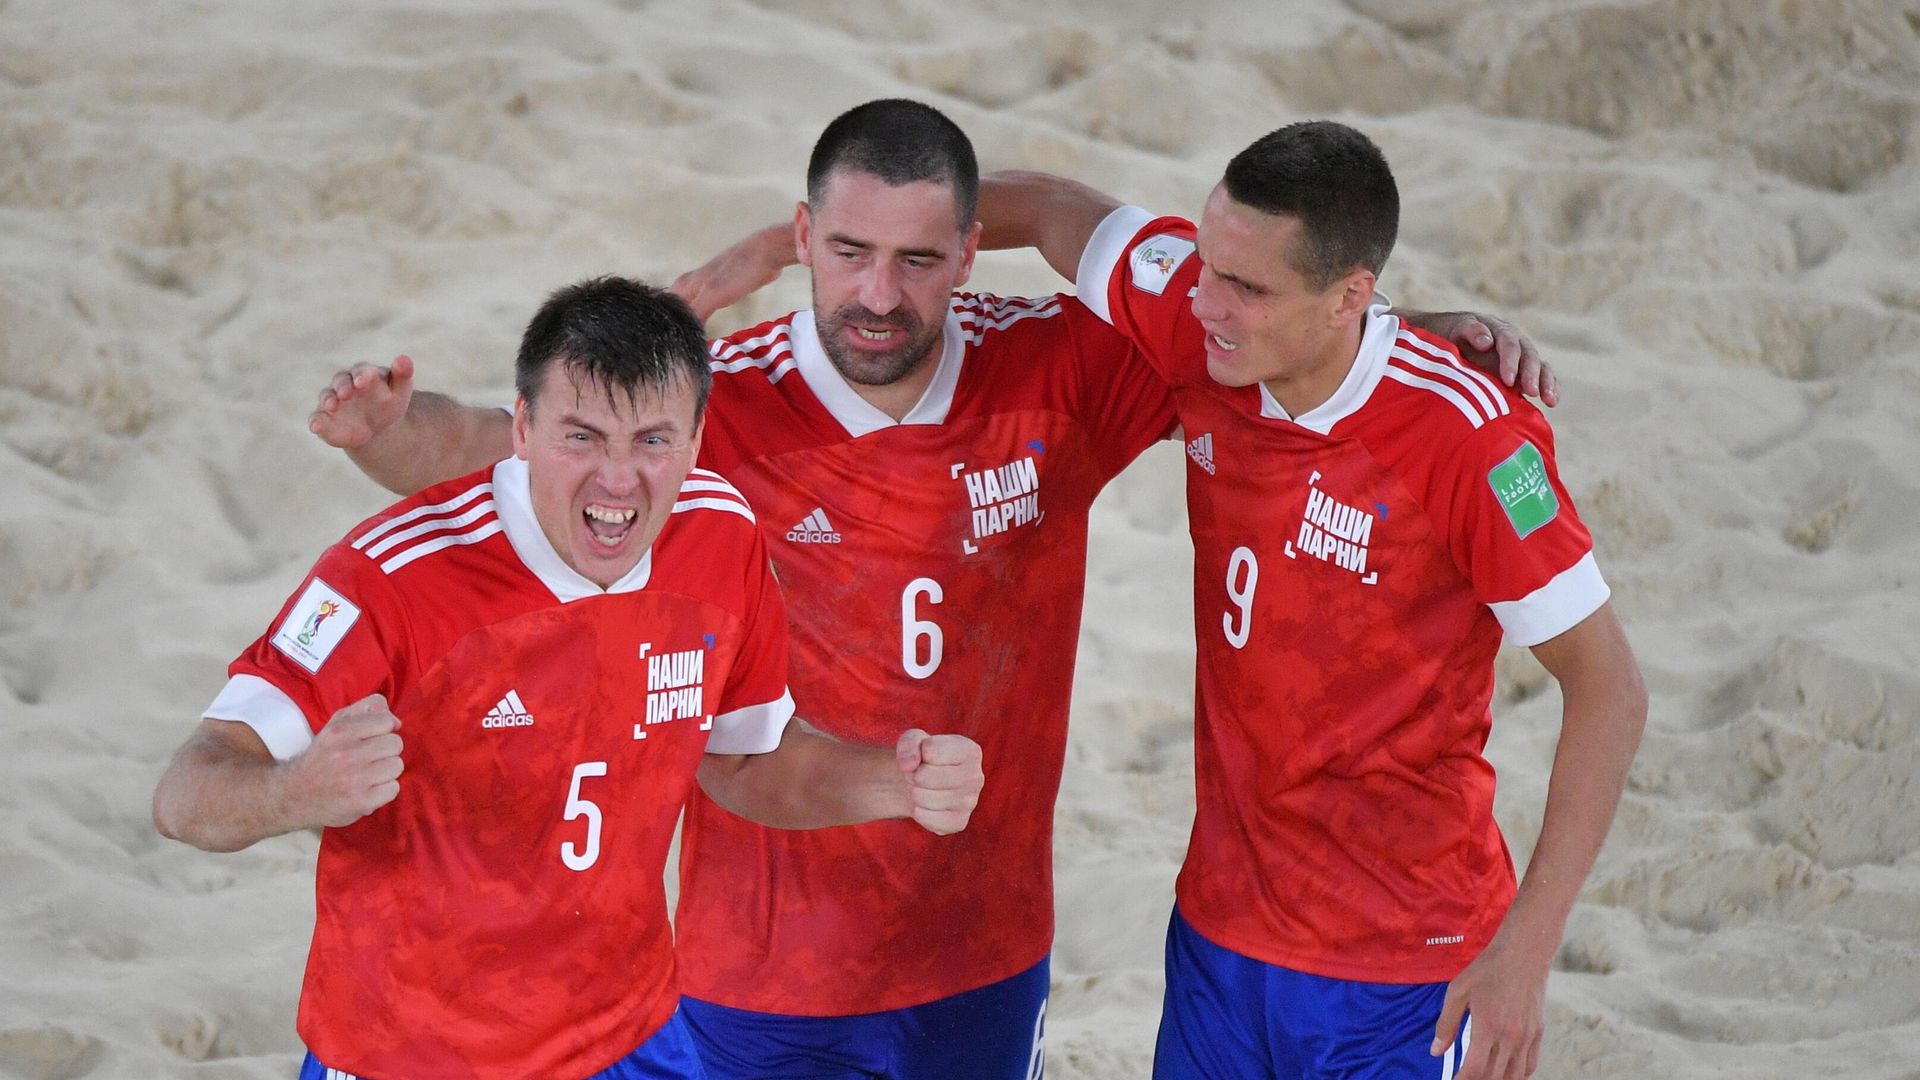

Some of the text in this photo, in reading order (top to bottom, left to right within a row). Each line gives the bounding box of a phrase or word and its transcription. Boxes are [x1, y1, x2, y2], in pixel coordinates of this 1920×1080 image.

[964, 457, 1039, 508] НАШИ
[1187, 444, 1216, 475] adidas
[786, 530, 841, 544] adidas
[972, 492, 1039, 538] ПАРНИ
[1304, 487, 1374, 546] НАШИ
[1297, 521, 1368, 573] ПАРНИ
[1223, 546, 1259, 649] 9
[902, 577, 943, 679] 6
[647, 649, 704, 691] НАШИ
[482, 713, 534, 728] adidas
[646, 687, 702, 725] ПАРНИ
[561, 761, 607, 871] 5
[1426, 935, 1464, 945] AEROREADY
